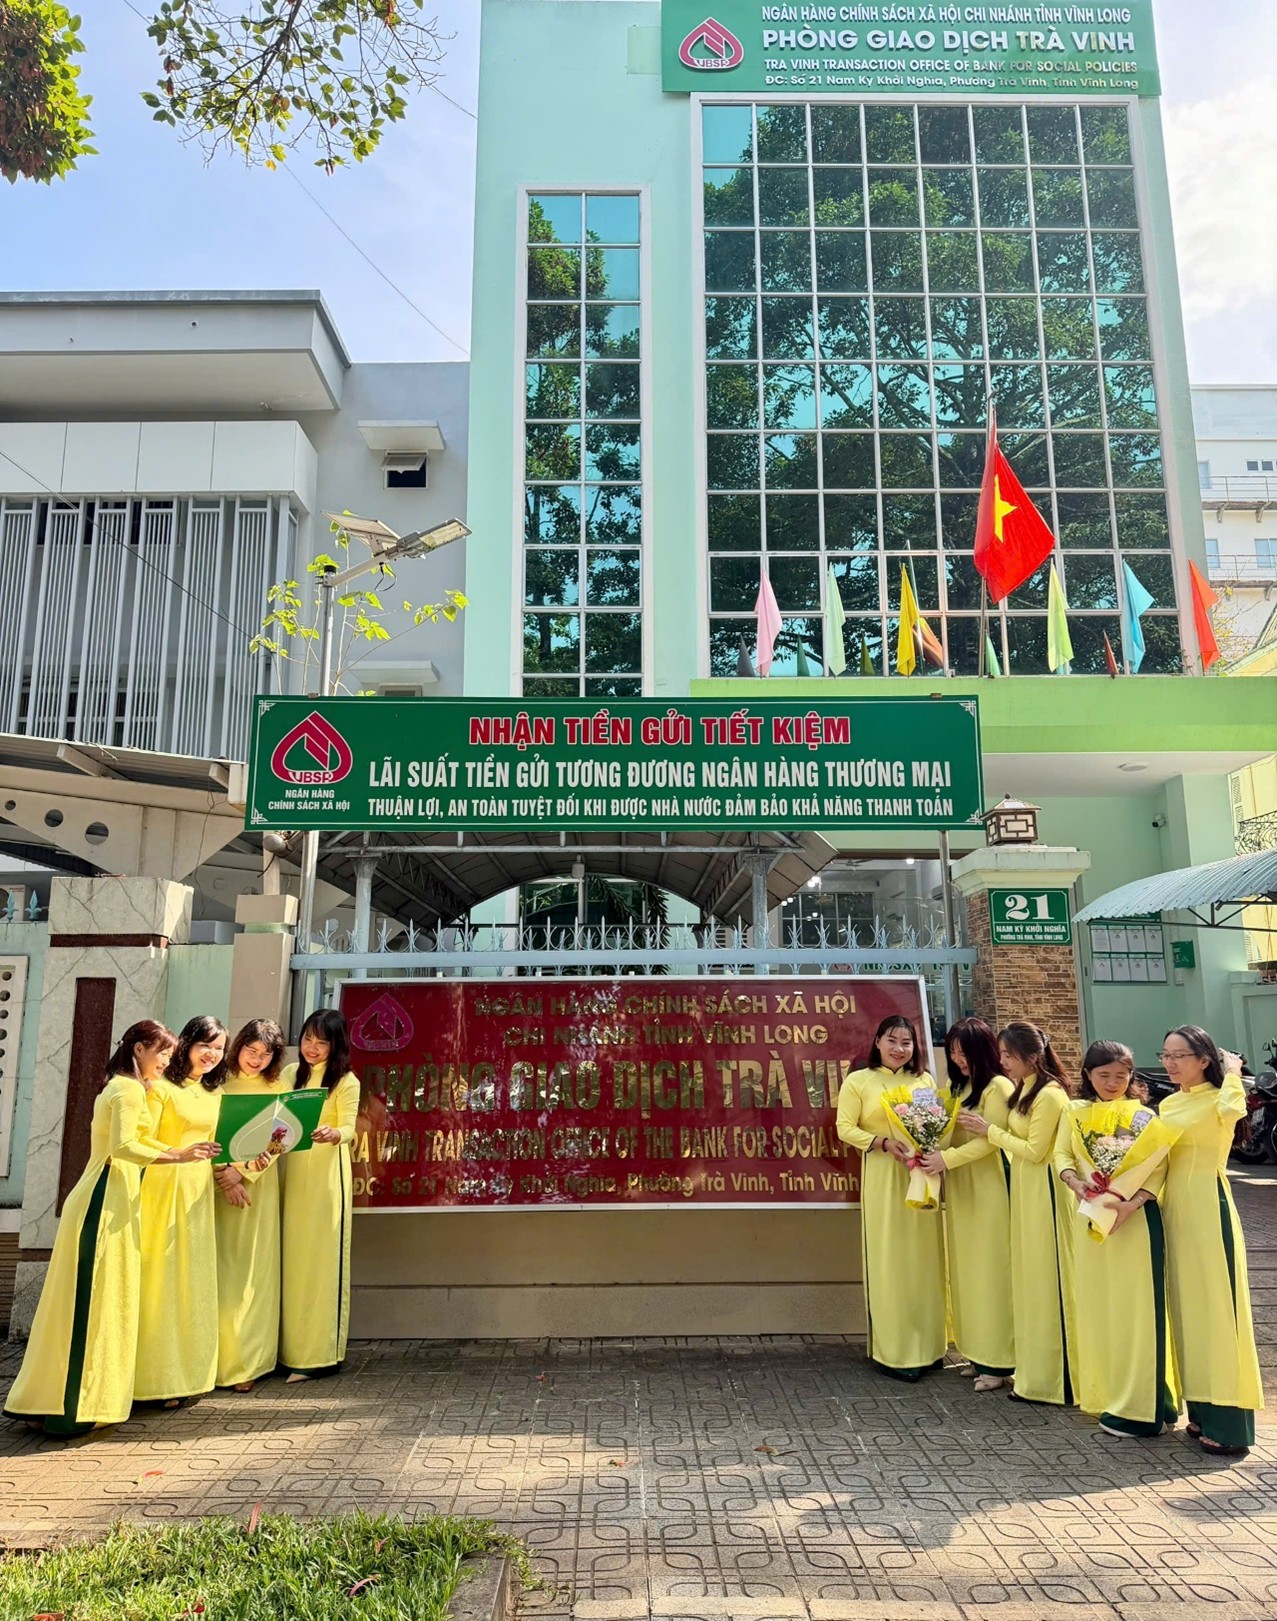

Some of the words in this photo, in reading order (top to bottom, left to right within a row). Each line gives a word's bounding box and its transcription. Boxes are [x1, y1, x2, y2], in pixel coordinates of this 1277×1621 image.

[762, 3, 798, 20] NGÂN
[801, 3, 836, 20] HÀNG
[839, 3, 878, 20] CHÍNH
[882, 3, 915, 20] SÁCH
[919, 4, 936, 20] XÃ
[939, 4, 961, 25] HỘI
[964, 7, 986, 21] CHI
[989, 4, 1032, 22] NHÁNH
[1035, 3, 1062, 22] TỈNH
[1064, 5, 1094, 22] VĨNH
[1097, 8, 1131, 23] LONG
[763, 23, 858, 49] PHÒNG
[867, 30, 935, 49] GIAO
[943, 30, 1008, 53] DỊCH
[1016, 25, 1065, 50] TRÀ
[1071, 32, 1135, 51] VINH
[765, 59, 787, 70] TRA
[790, 59, 819, 70] VINH
[823, 59, 905, 71] TRANSACTION
[909, 60, 950, 71] OFFICE
[954, 60, 969, 71] OF
[973, 60, 1006, 71] BANK
[1010, 61, 1032, 72] FOR
[1037, 61, 1081, 72] SOCIAL
[1085, 61, 1137, 72] POLICIES
[765, 76, 787, 84] ĐC:
[790, 73, 806, 85] Số
[809, 76, 822, 84] 21
[827, 76, 855, 84] Nam
[1110, 78, 1139, 89] Long
[469, 711, 555, 751] NHẬN
[563, 708, 633, 746] TIỀN
[640, 708, 692, 746] GỬI
[700, 708, 764, 745] TIẾT
[772, 711, 851, 750] KIỆM
[369, 756, 400, 787] LÃI
[407, 752, 459, 788] SUẤT
[465, 753, 510, 788] TIỀN
[516, 753, 549, 788] GỬI
[555, 759, 621, 788] TƯƠNG
[628, 759, 695, 788] ĐƯƠNG
[702, 756, 757, 788] NGÂN
[764, 756, 819, 787] HÀNG
[825, 759, 905, 787] THƯƠNG
[912, 761, 951, 793] MẠI
[268, 800, 295, 810] CHÍNH
[297, 800, 320, 810] SÁCH
[322, 800, 333, 810] XÃ
[335, 800, 350, 812] HỘI
[285, 788, 309, 798] NGÂN
[311, 788, 335, 798] HÀNG
[368, 796, 414, 819] THUẬN
[418, 797, 444, 819] LỢI,
[448, 799, 468, 816] AN
[472, 796, 507, 816] TOÀN
[511, 796, 552, 820] TUYỆT
[556, 793, 579, 816] ĐỐI
[584, 799, 606, 816] KHI
[610, 797, 647, 819] ĐƯỢC
[651, 795, 680, 816] NHÀ
[684, 794, 721, 816] NƯỚC
[725, 793, 756, 816] ĐẢM
[760, 793, 788, 816] BẢO
[792, 793, 820, 816] KHẢ
[824, 796, 863, 816] NĂNG
[866, 799, 912, 816] THANH
[916, 795, 953, 816] TOÁN
[1004, 894, 1054, 921] 21
[475, 991, 543, 1016] NGÂN
[625, 990, 698, 1015] CHÍNH
[704, 989, 768, 1015] SÁCH
[775, 991, 808, 1015] XÃ
[815, 990, 856, 1019] HỘI
[504, 1026, 545, 1046] CHI
[645, 1018, 693, 1045] TỈNH
[700, 1021, 756, 1045] VĨNH
[764, 1025, 829, 1045] LONG
[361, 1052, 495, 1112] PHÒNG
[509, 1060, 599, 1111] GIAO
[613, 1060, 705, 1119] DỊCH
[716, 1051, 793, 1109] TRÀ
[377, 1130, 419, 1162] VINH
[425, 1128, 545, 1161] TRANSACTION
[615, 1127, 638, 1159] OF
[645, 1126, 673, 1158] THE
[680, 1126, 728, 1159] BANK
[733, 1126, 767, 1158] FOR
[772, 1126, 839, 1158] SOCIAL
[419, 1176, 437, 1195] 21
[627, 1171, 694, 1198] Phường
[700, 1171, 726, 1192] Trà
[731, 1172, 774, 1195] Vinh,
[779, 1169, 815, 1192] Tỉnh
[820, 1170, 859, 1192] Vĩnh
